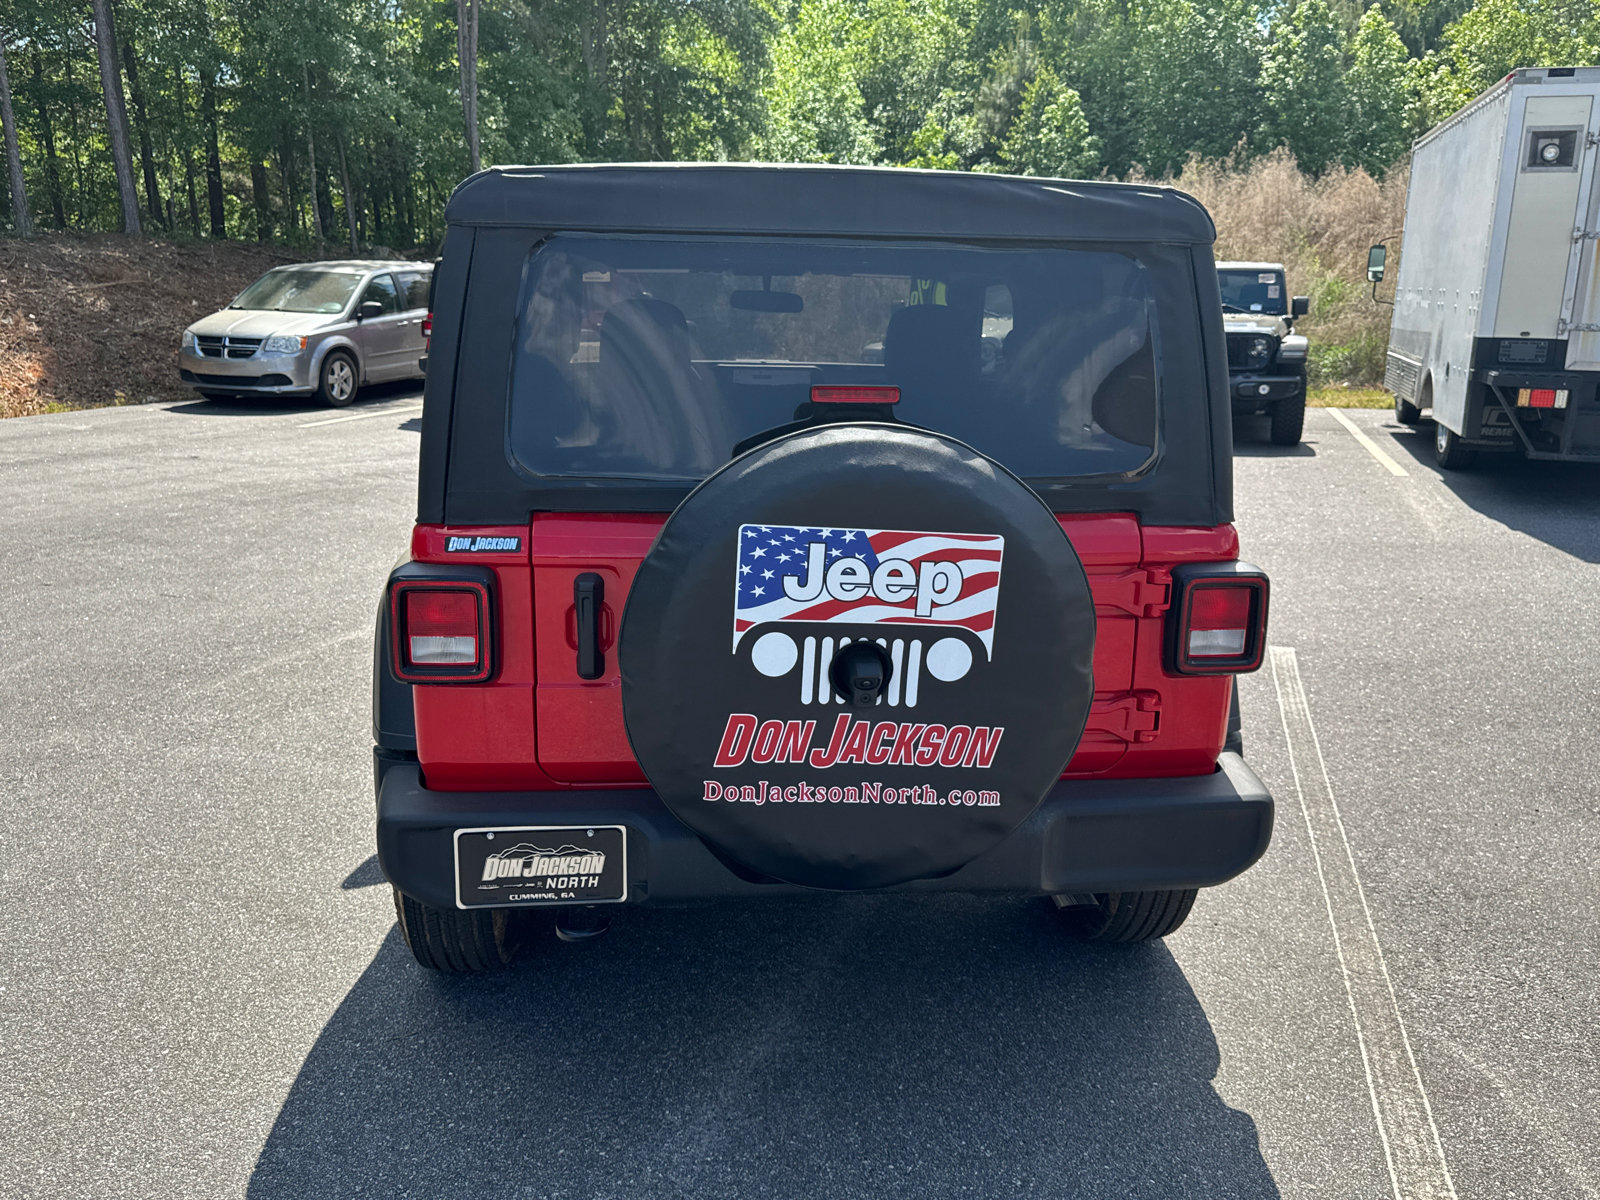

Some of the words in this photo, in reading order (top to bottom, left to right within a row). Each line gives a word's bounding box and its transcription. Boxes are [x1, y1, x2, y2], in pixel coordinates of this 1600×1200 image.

[447, 536, 472, 552] DON
[470, 536, 518, 552] JACKSON
[781, 541, 964, 618] Jeep
[713, 712, 817, 768] DON
[809, 712, 1005, 769] JACKSON
[703, 780, 1001, 807] DonJacksonNorth.com
[481, 857, 524, 882] DON
[522, 855, 606, 878] JACKSON
[509, 892, 558, 901] CUMMING,
[560, 891, 576, 899] GA
[545, 876, 599, 889] NORTH
